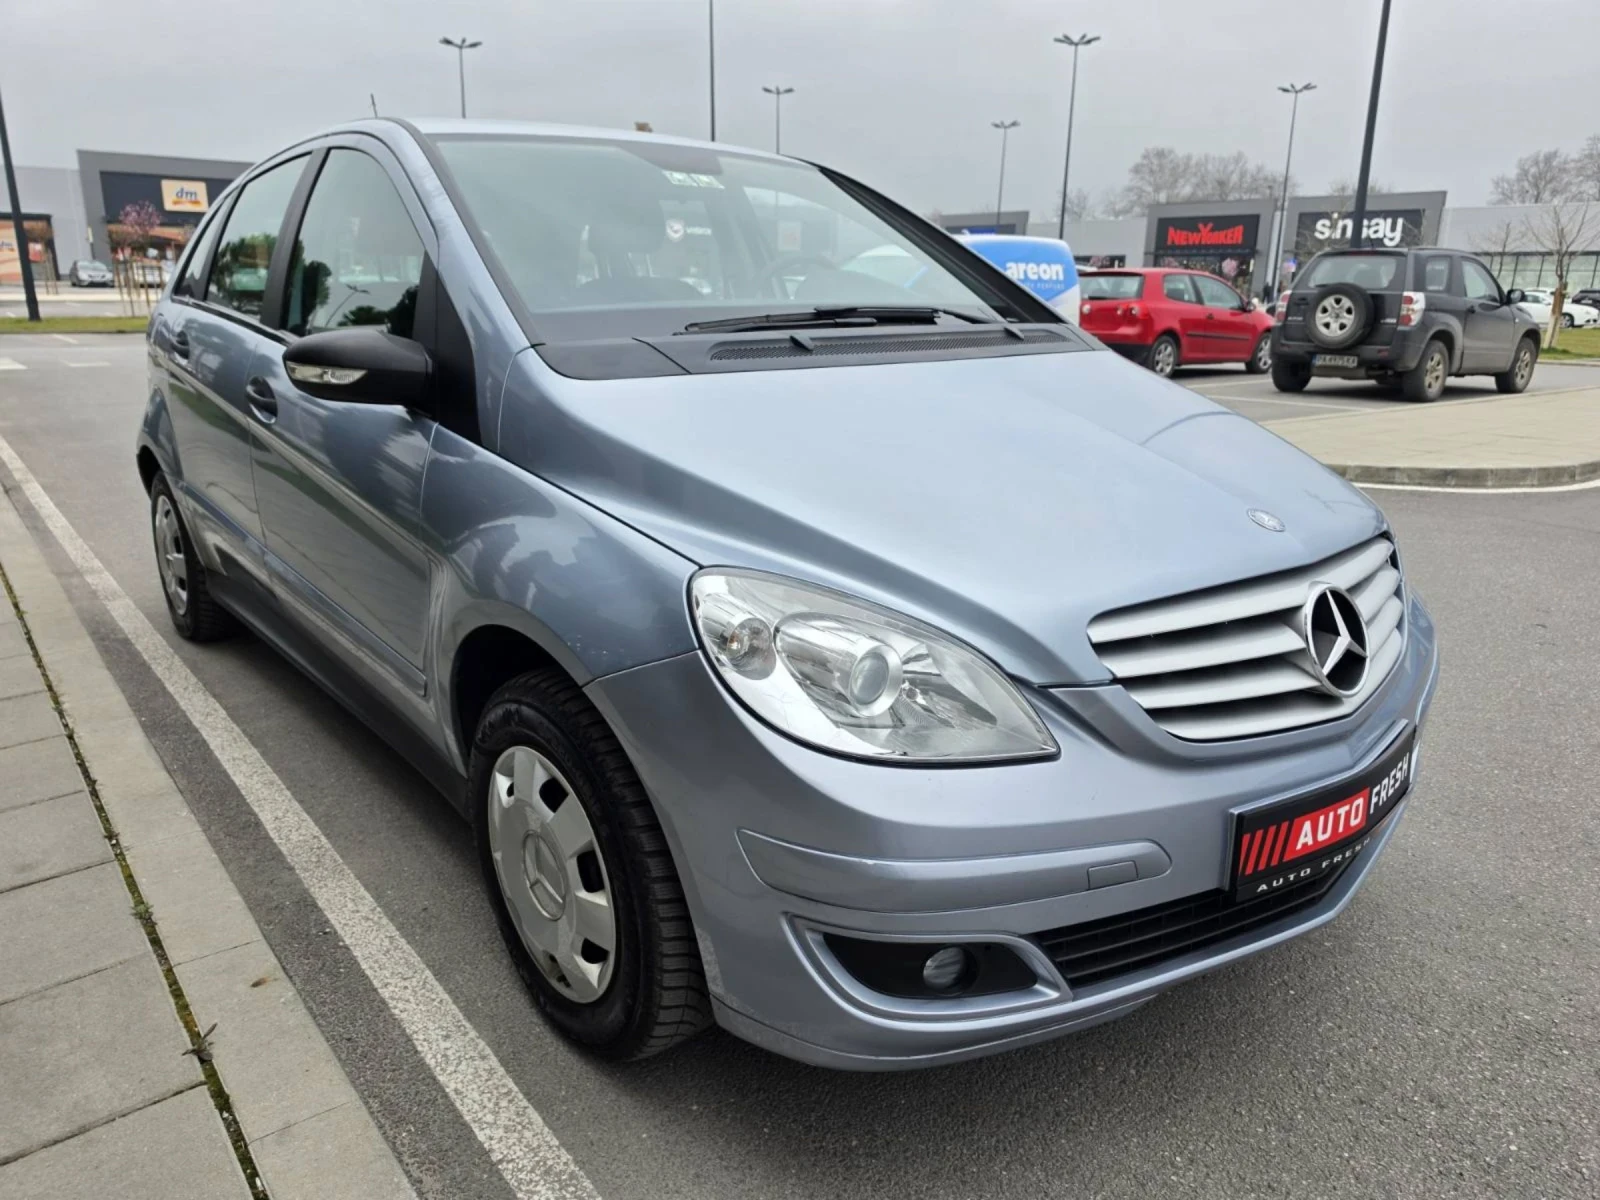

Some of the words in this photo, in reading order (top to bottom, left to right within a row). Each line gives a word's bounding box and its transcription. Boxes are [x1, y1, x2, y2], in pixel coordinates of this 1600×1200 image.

[175, 187, 198, 200] dm
[1004, 261, 1064, 281] areon
[1296, 797, 1364, 850] AUTO
[1369, 752, 1409, 814] FRESH
[1256, 868, 1311, 892] AUTO
